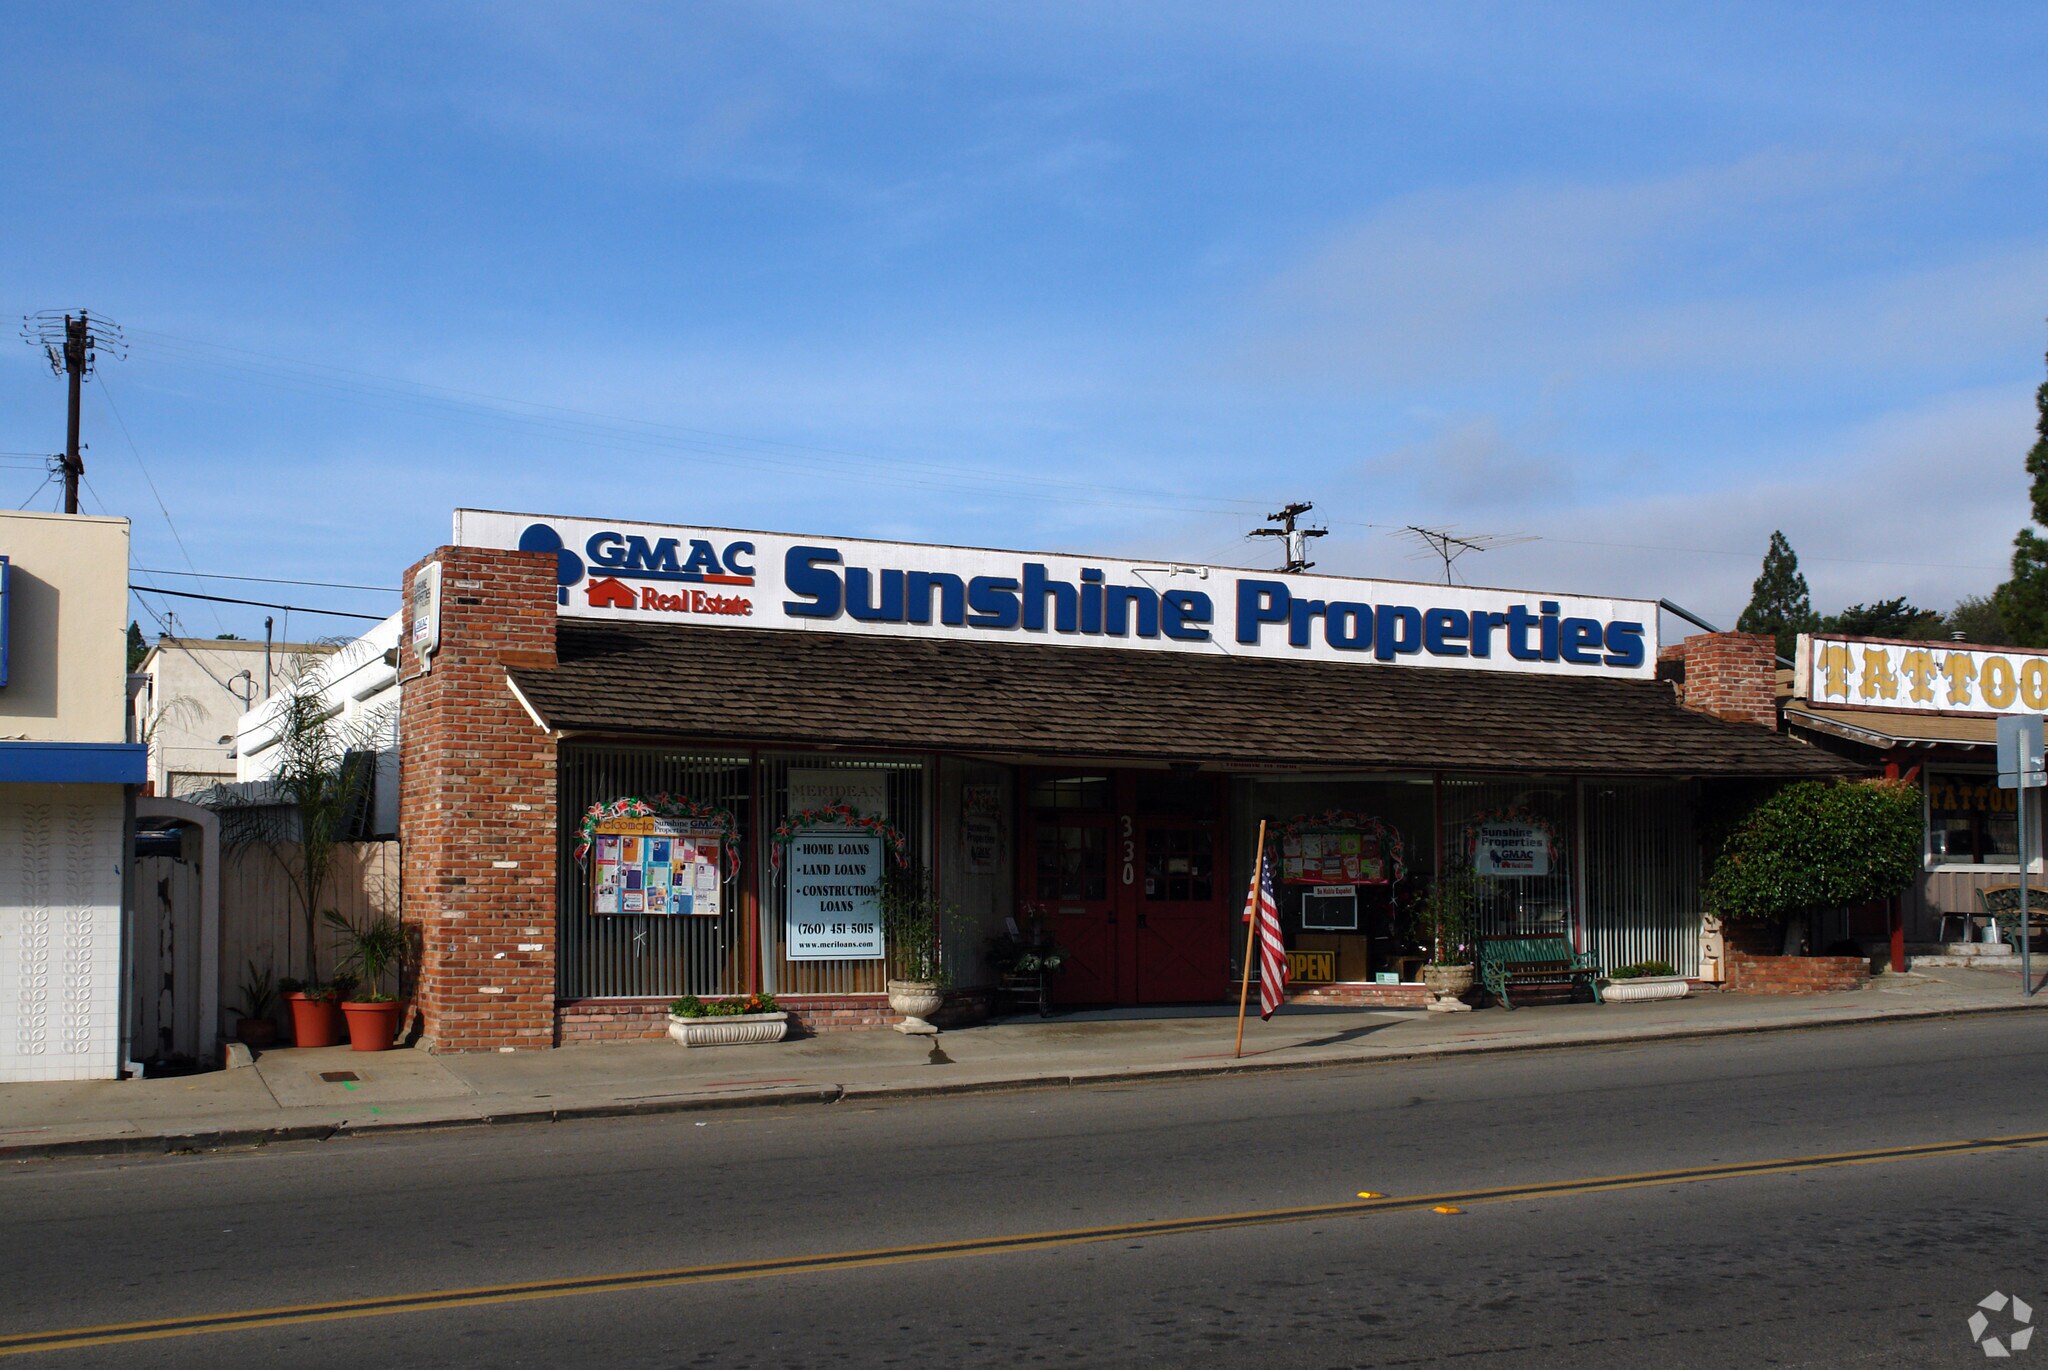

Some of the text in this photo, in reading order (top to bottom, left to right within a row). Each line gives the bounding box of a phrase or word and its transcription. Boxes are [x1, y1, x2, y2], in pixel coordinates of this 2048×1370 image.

[586, 531, 754, 575] GMAC
[640, 587, 753, 617] Real Estate
[783, 545, 1645, 667] Sunshine Properties
[792, 784, 882, 797] MERIDEAN
[654, 818, 688, 828] Sunshine
[655, 826, 688, 834] Properties
[1481, 827, 1533, 837] Sunshine
[1481, 837, 1543, 848] Properties
[803, 844, 870, 855] HOME LOANS
[1120, 815, 1135, 886] 330
[1501, 850, 1534, 859] GMAC
[803, 864, 866, 875] LAND LOANS
[803, 885, 877, 897] CONSTRUCTION
[820, 900, 854, 912] LOANS
[798, 922, 874, 935] (760) 451-5015
[799, 940, 874, 948] www.meriloans.com
[1288, 953, 1332, 981] OPEN
